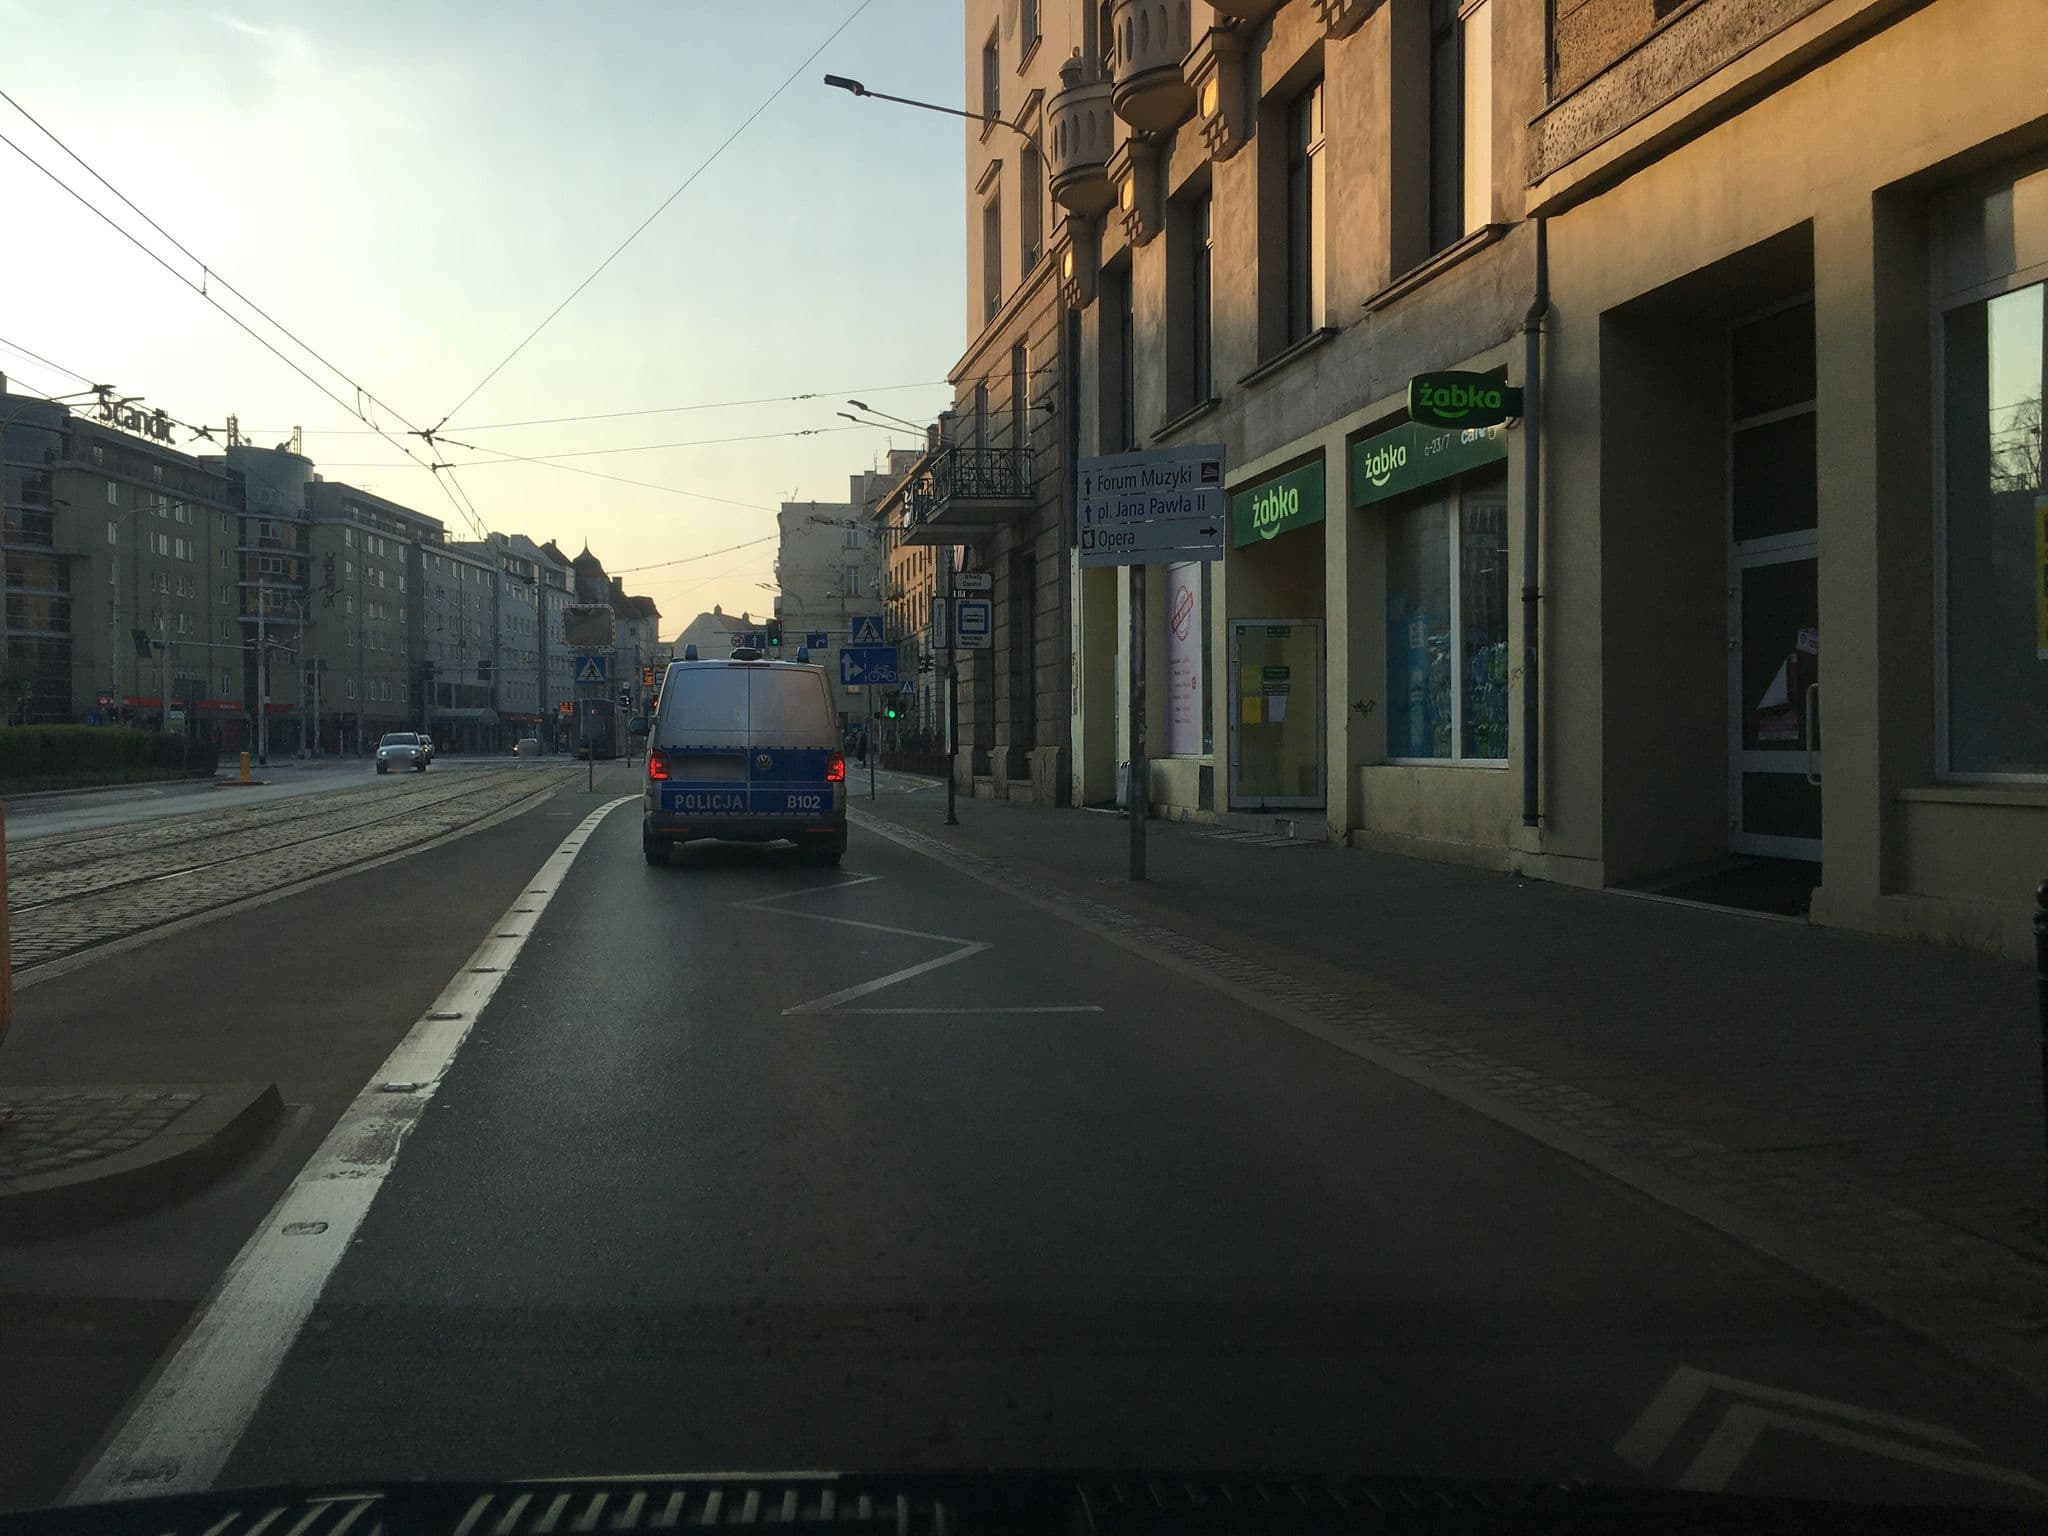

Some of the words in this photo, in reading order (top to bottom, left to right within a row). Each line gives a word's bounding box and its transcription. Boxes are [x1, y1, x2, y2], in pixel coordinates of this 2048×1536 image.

[1418, 382, 1503, 410] żabka
[99, 388, 176, 445] Scandic
[1364, 444, 1407, 479] żabka
[1097, 472, 1137, 491] Forum
[1141, 465, 1192, 489] Muzyki
[1098, 500, 1112, 522] pl.
[1116, 501, 1145, 517] Jana
[1150, 494, 1191, 514] Pawła
[1197, 494, 1206, 511] II
[1252, 484, 1299, 528] żabka
[1098, 530, 1135, 550] Opera
[675, 794, 743, 809] POLICJA
[787, 795, 821, 809] B102
